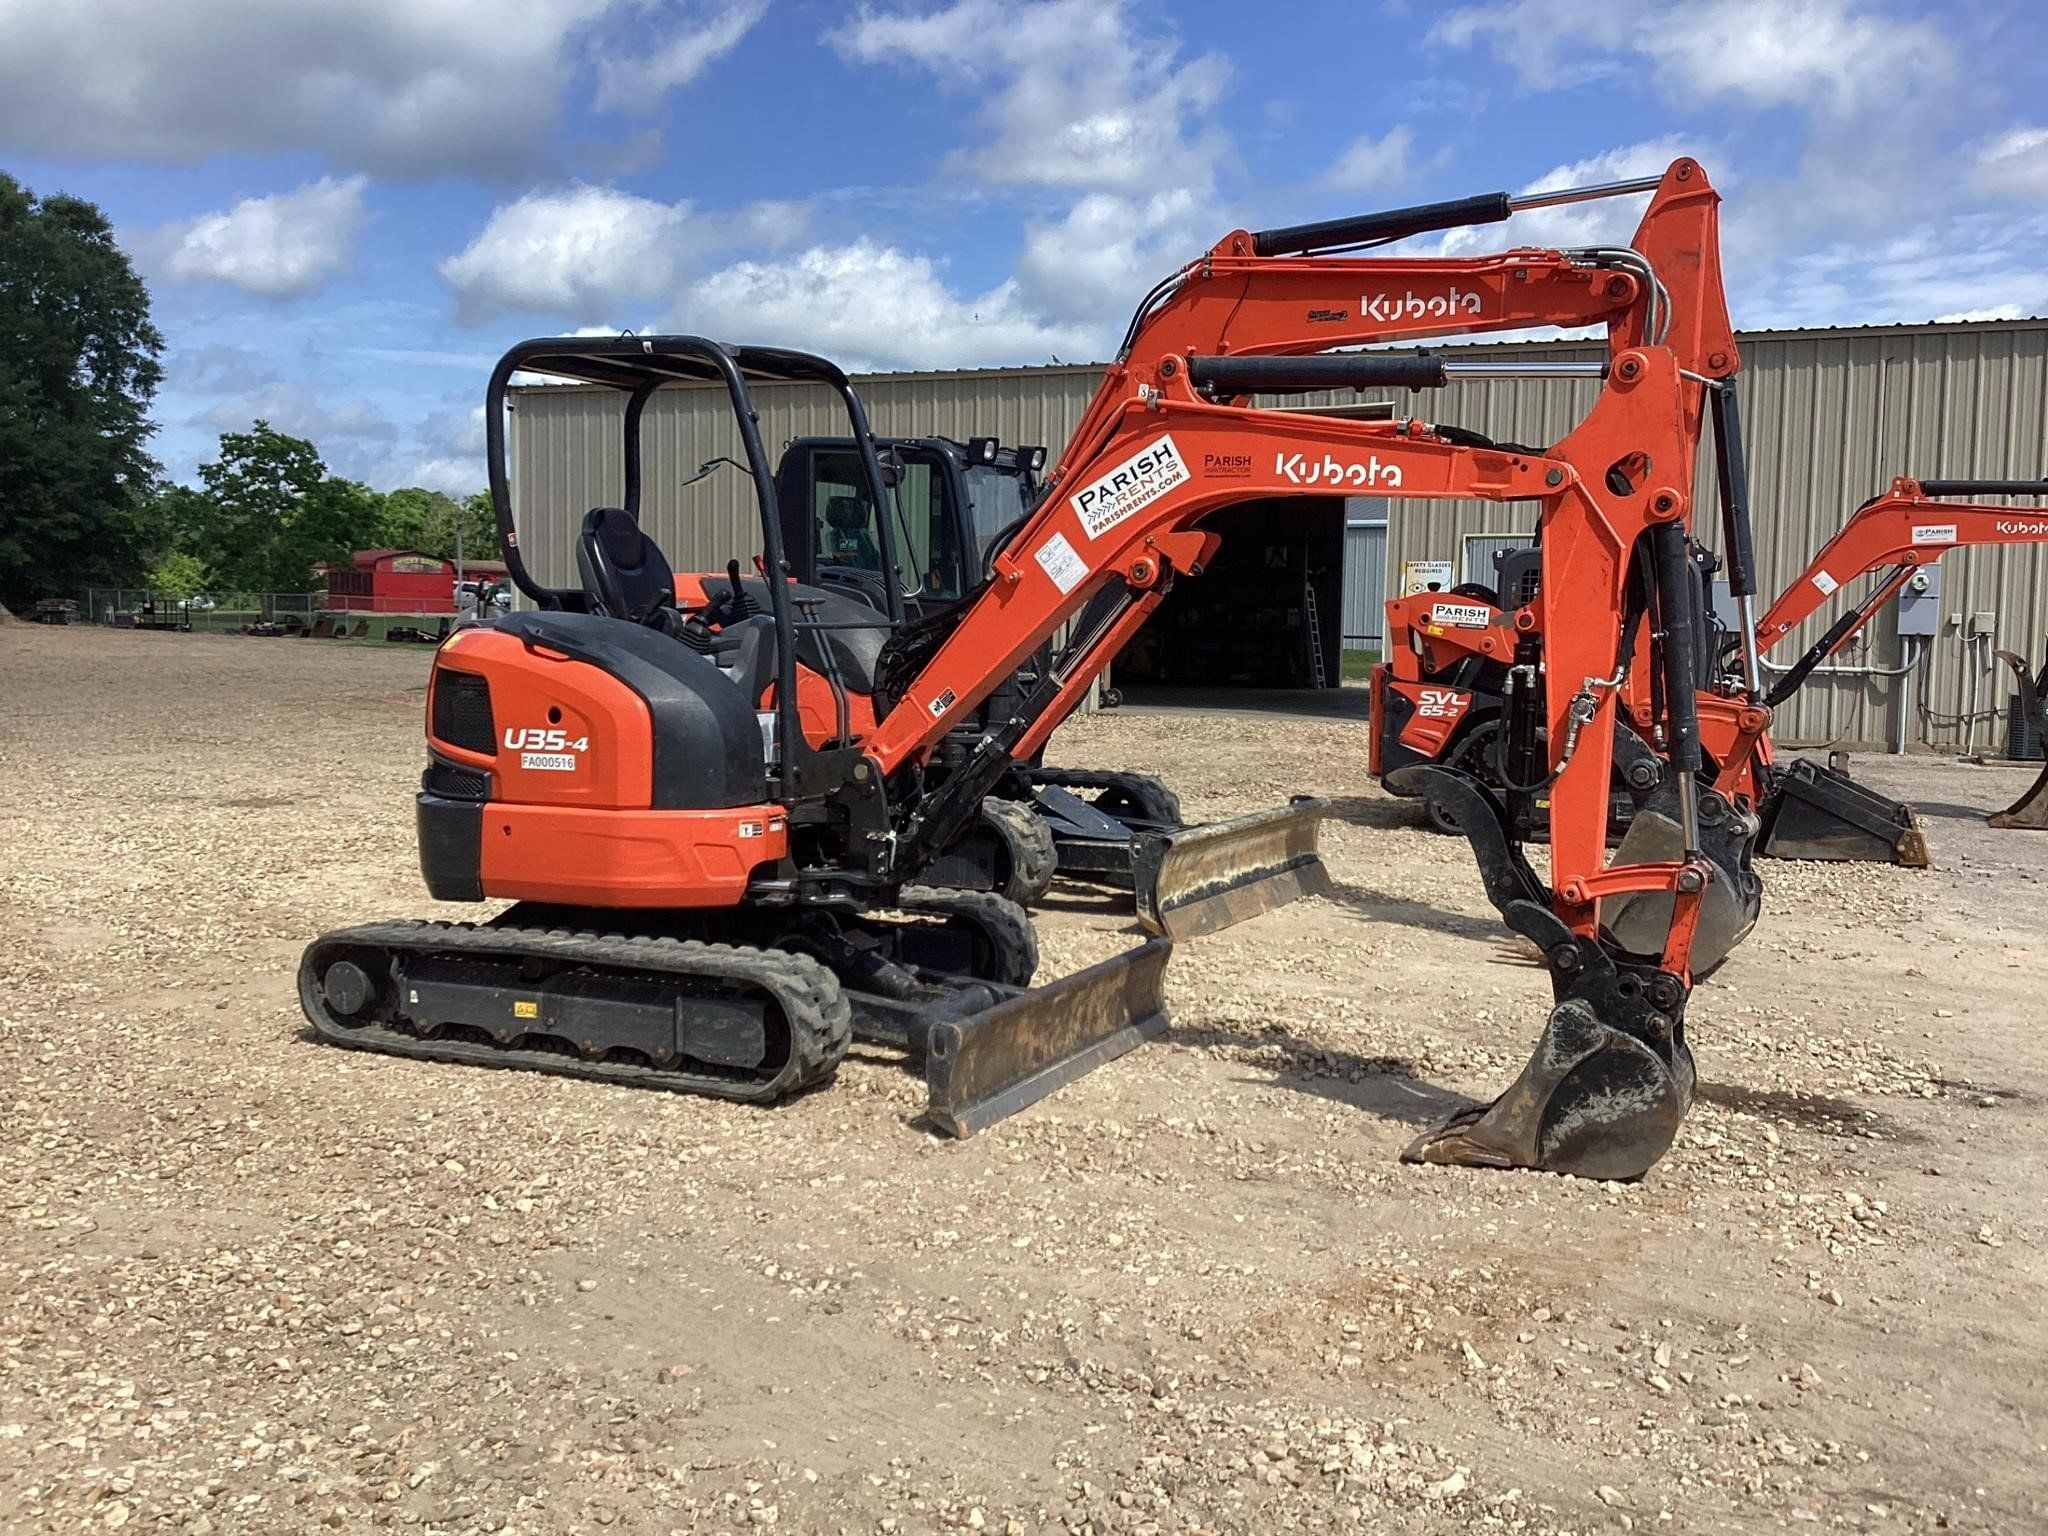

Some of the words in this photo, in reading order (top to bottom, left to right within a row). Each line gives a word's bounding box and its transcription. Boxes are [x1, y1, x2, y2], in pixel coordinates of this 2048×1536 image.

[1360, 286, 1482, 322] Kubota
[1204, 454, 1252, 467] PARISH
[1274, 452, 1403, 487] Kubota
[1078, 443, 1173, 513] PARISH
[1115, 459, 1180, 506] RENTS
[1091, 471, 1183, 533] PARISHRENTS.COM
[1436, 605, 1486, 617] PARISH
[1417, 690, 1468, 705] SVL
[1419, 704, 1459, 717] 65-2
[504, 728, 588, 752] U35-4
[522, 756, 574, 768] FA000516
